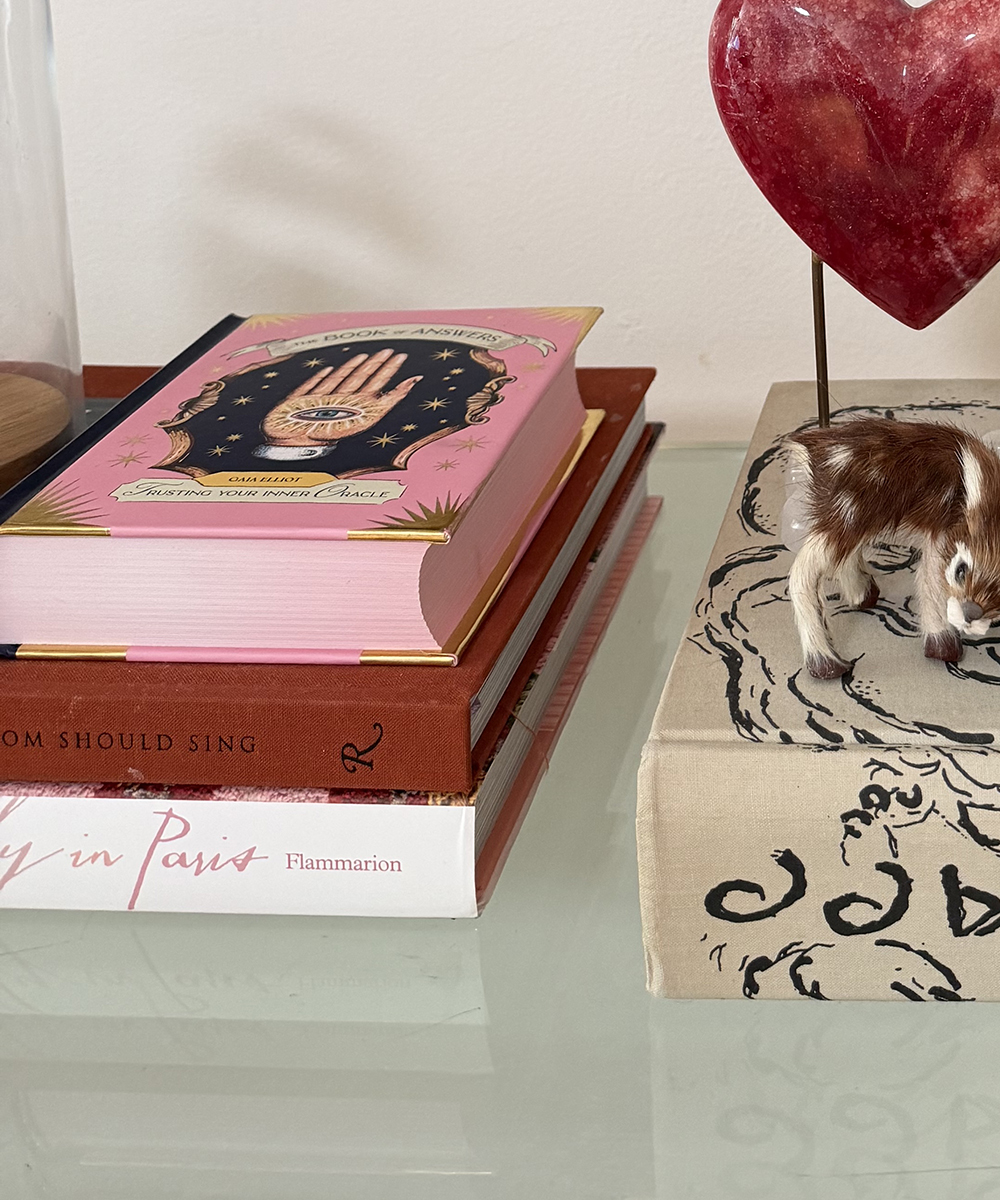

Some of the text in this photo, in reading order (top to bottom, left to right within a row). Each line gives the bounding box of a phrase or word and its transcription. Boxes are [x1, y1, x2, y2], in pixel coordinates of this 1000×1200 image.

[324, 327, 389, 342] BOOK
[411, 326, 501, 344] ANSWERS
[259, 476, 303, 484] ELLIOT
[217, 489, 258, 498] YOUR
[262, 490, 310, 499] INNER
[58, 731, 174, 751] SHOULD
[188, 734, 257, 754] SING
[70, 833, 124, 869] in
[128, 807, 269, 910] Paris
[285, 852, 403, 872] Flammarion
